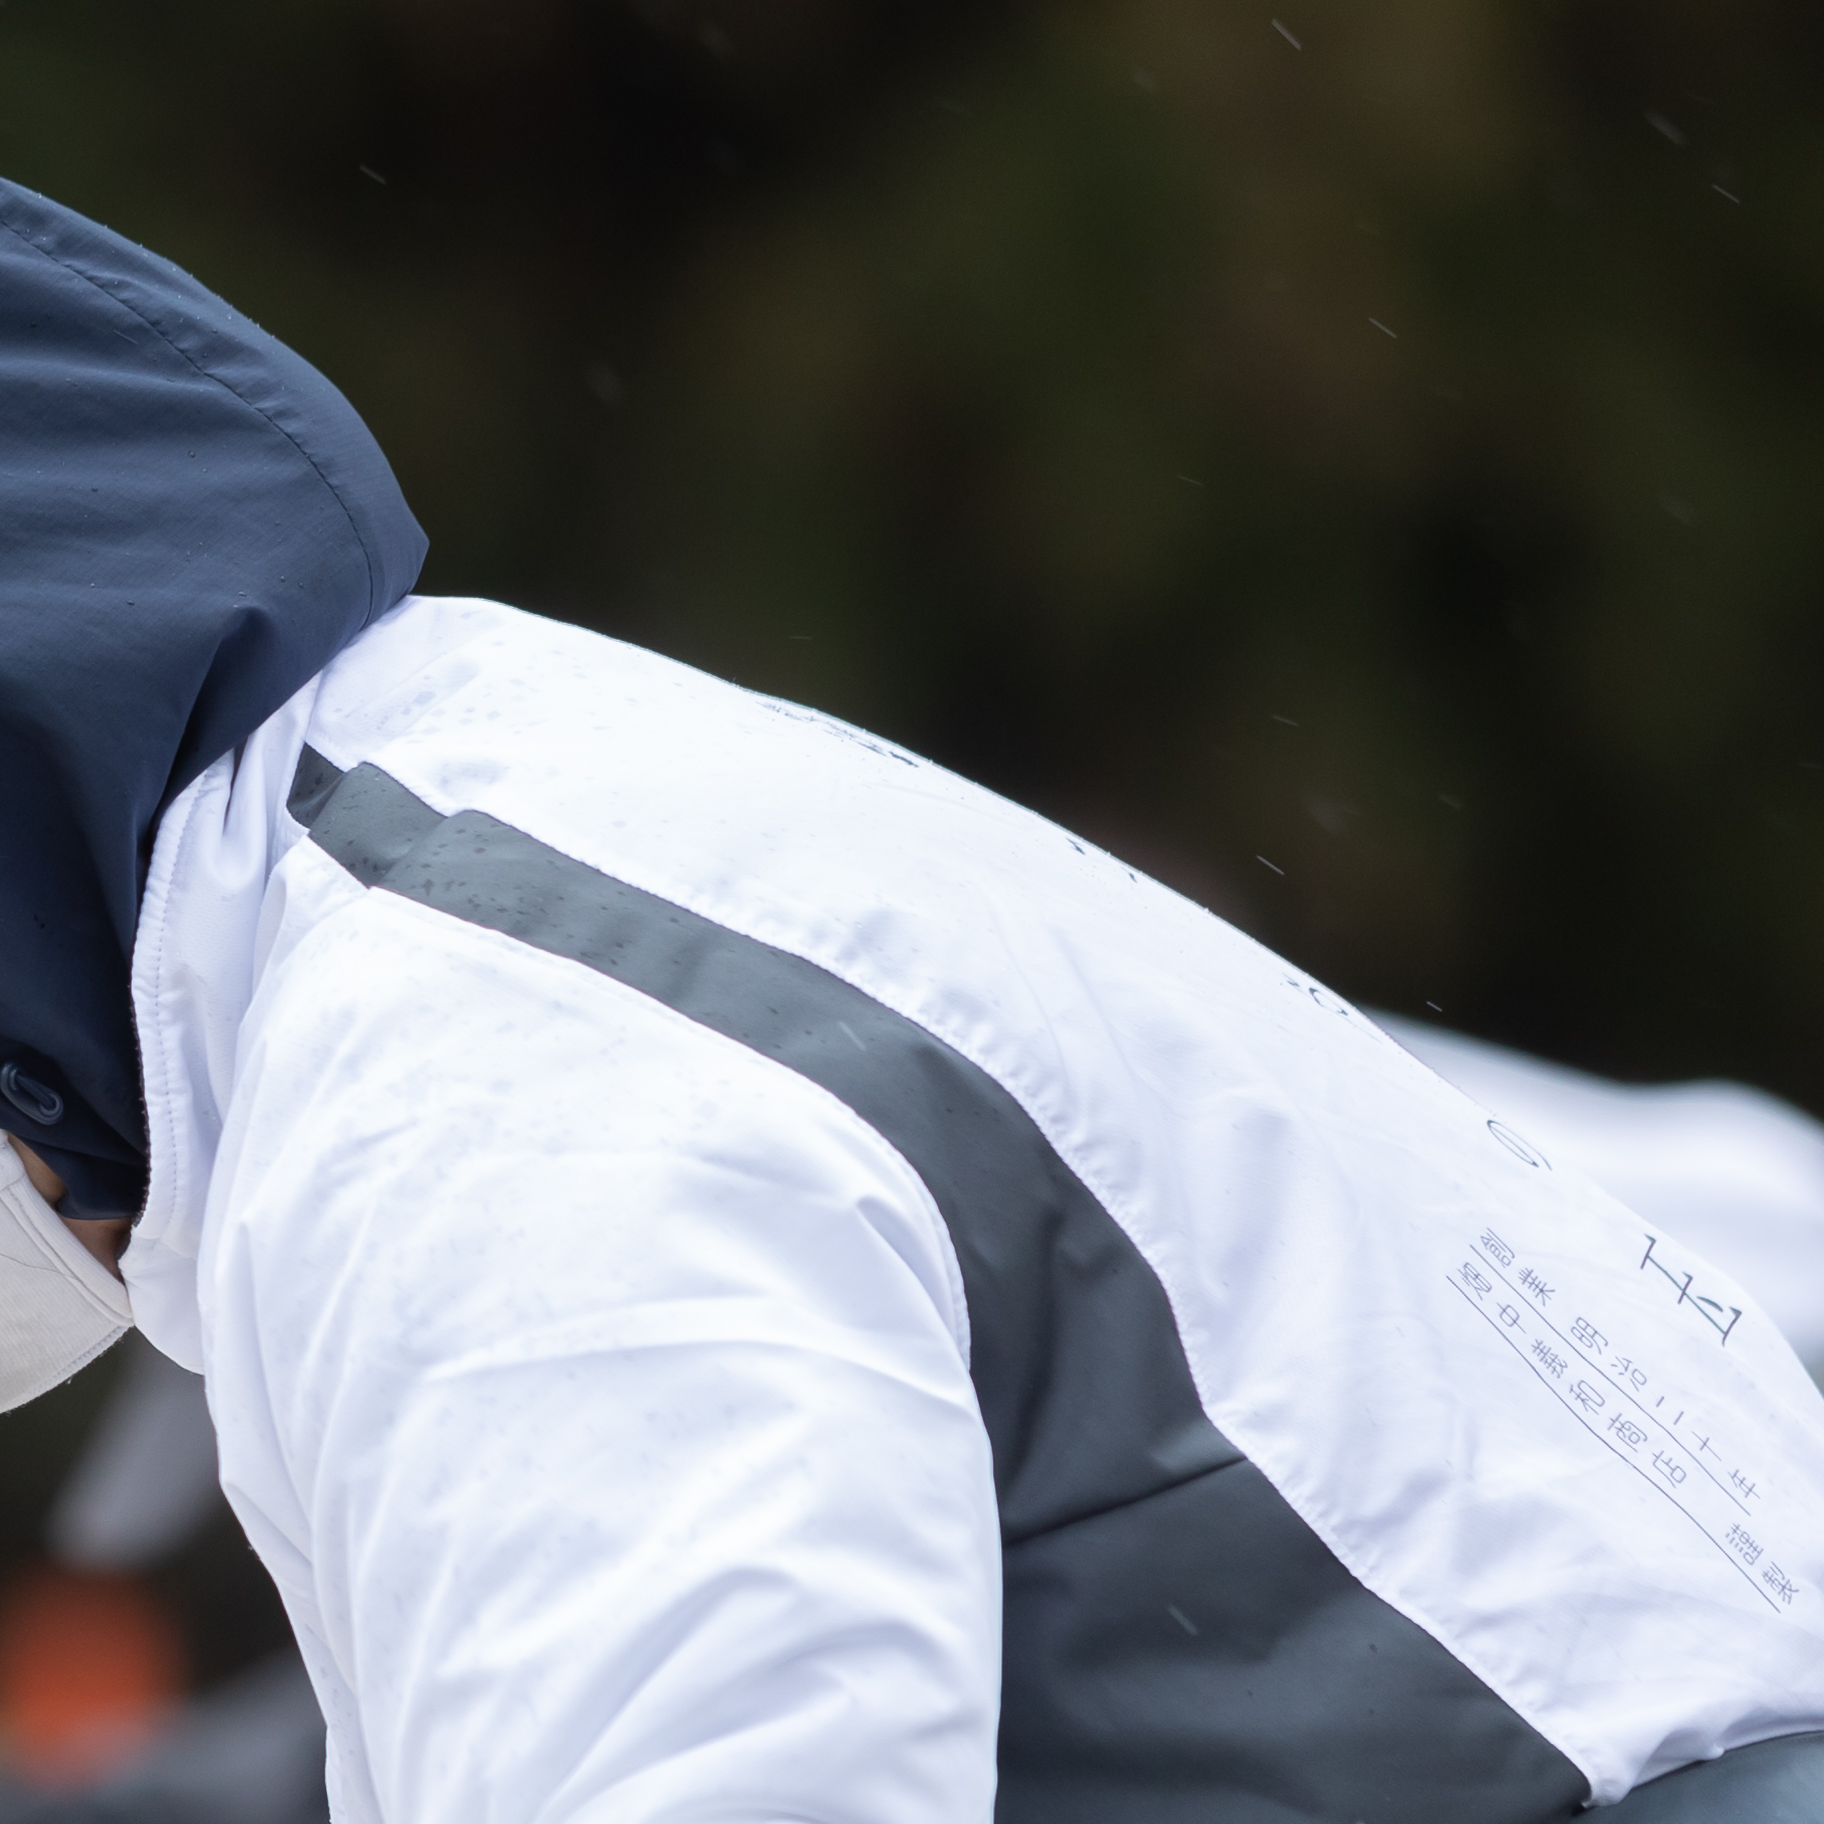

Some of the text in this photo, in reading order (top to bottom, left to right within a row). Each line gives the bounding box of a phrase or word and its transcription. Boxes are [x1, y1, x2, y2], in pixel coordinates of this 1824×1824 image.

[1456, 1261, 1801, 1606] 畑中義和商店 謹製
[1479, 1226, 1761, 1500] 創業 明治二十年
